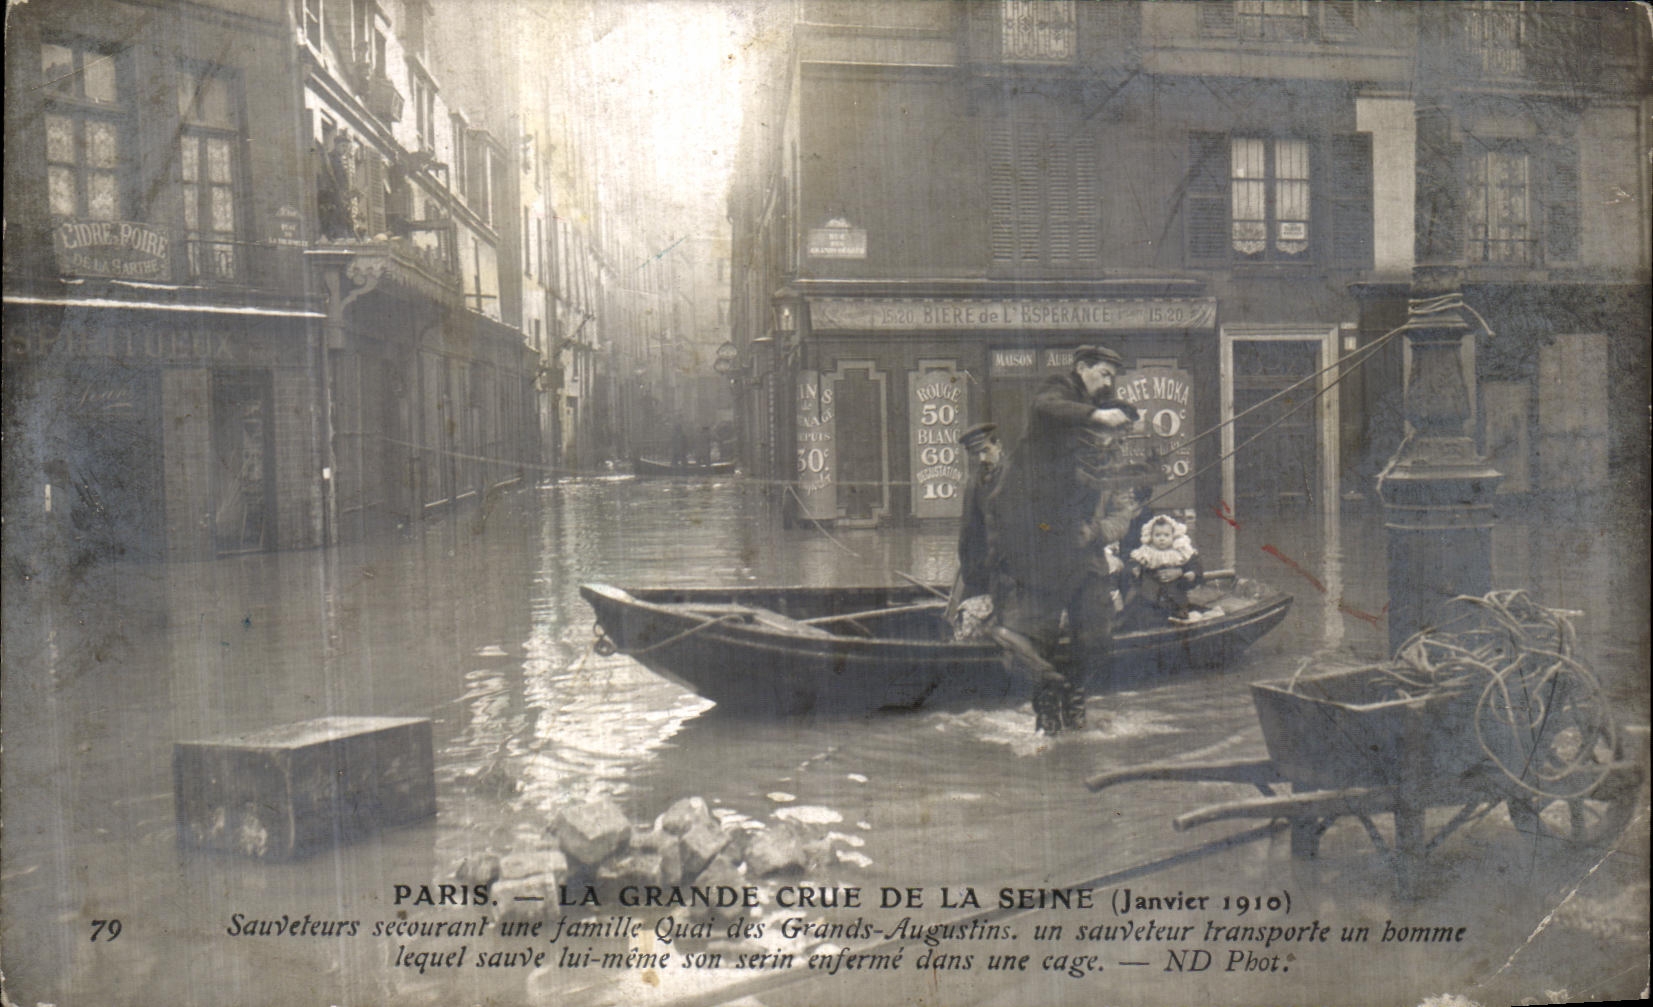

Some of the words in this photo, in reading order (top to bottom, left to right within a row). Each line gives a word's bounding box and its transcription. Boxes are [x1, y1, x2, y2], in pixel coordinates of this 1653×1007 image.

[61, 222, 111, 249] CIDRE
[112, 258, 160, 275] SARTHE
[980, 307, 998, 323] de
[995, 352, 1033, 367] MAISON
[916, 383, 962, 402] ROUGE
[1152, 376, 1189, 406] MOKA
